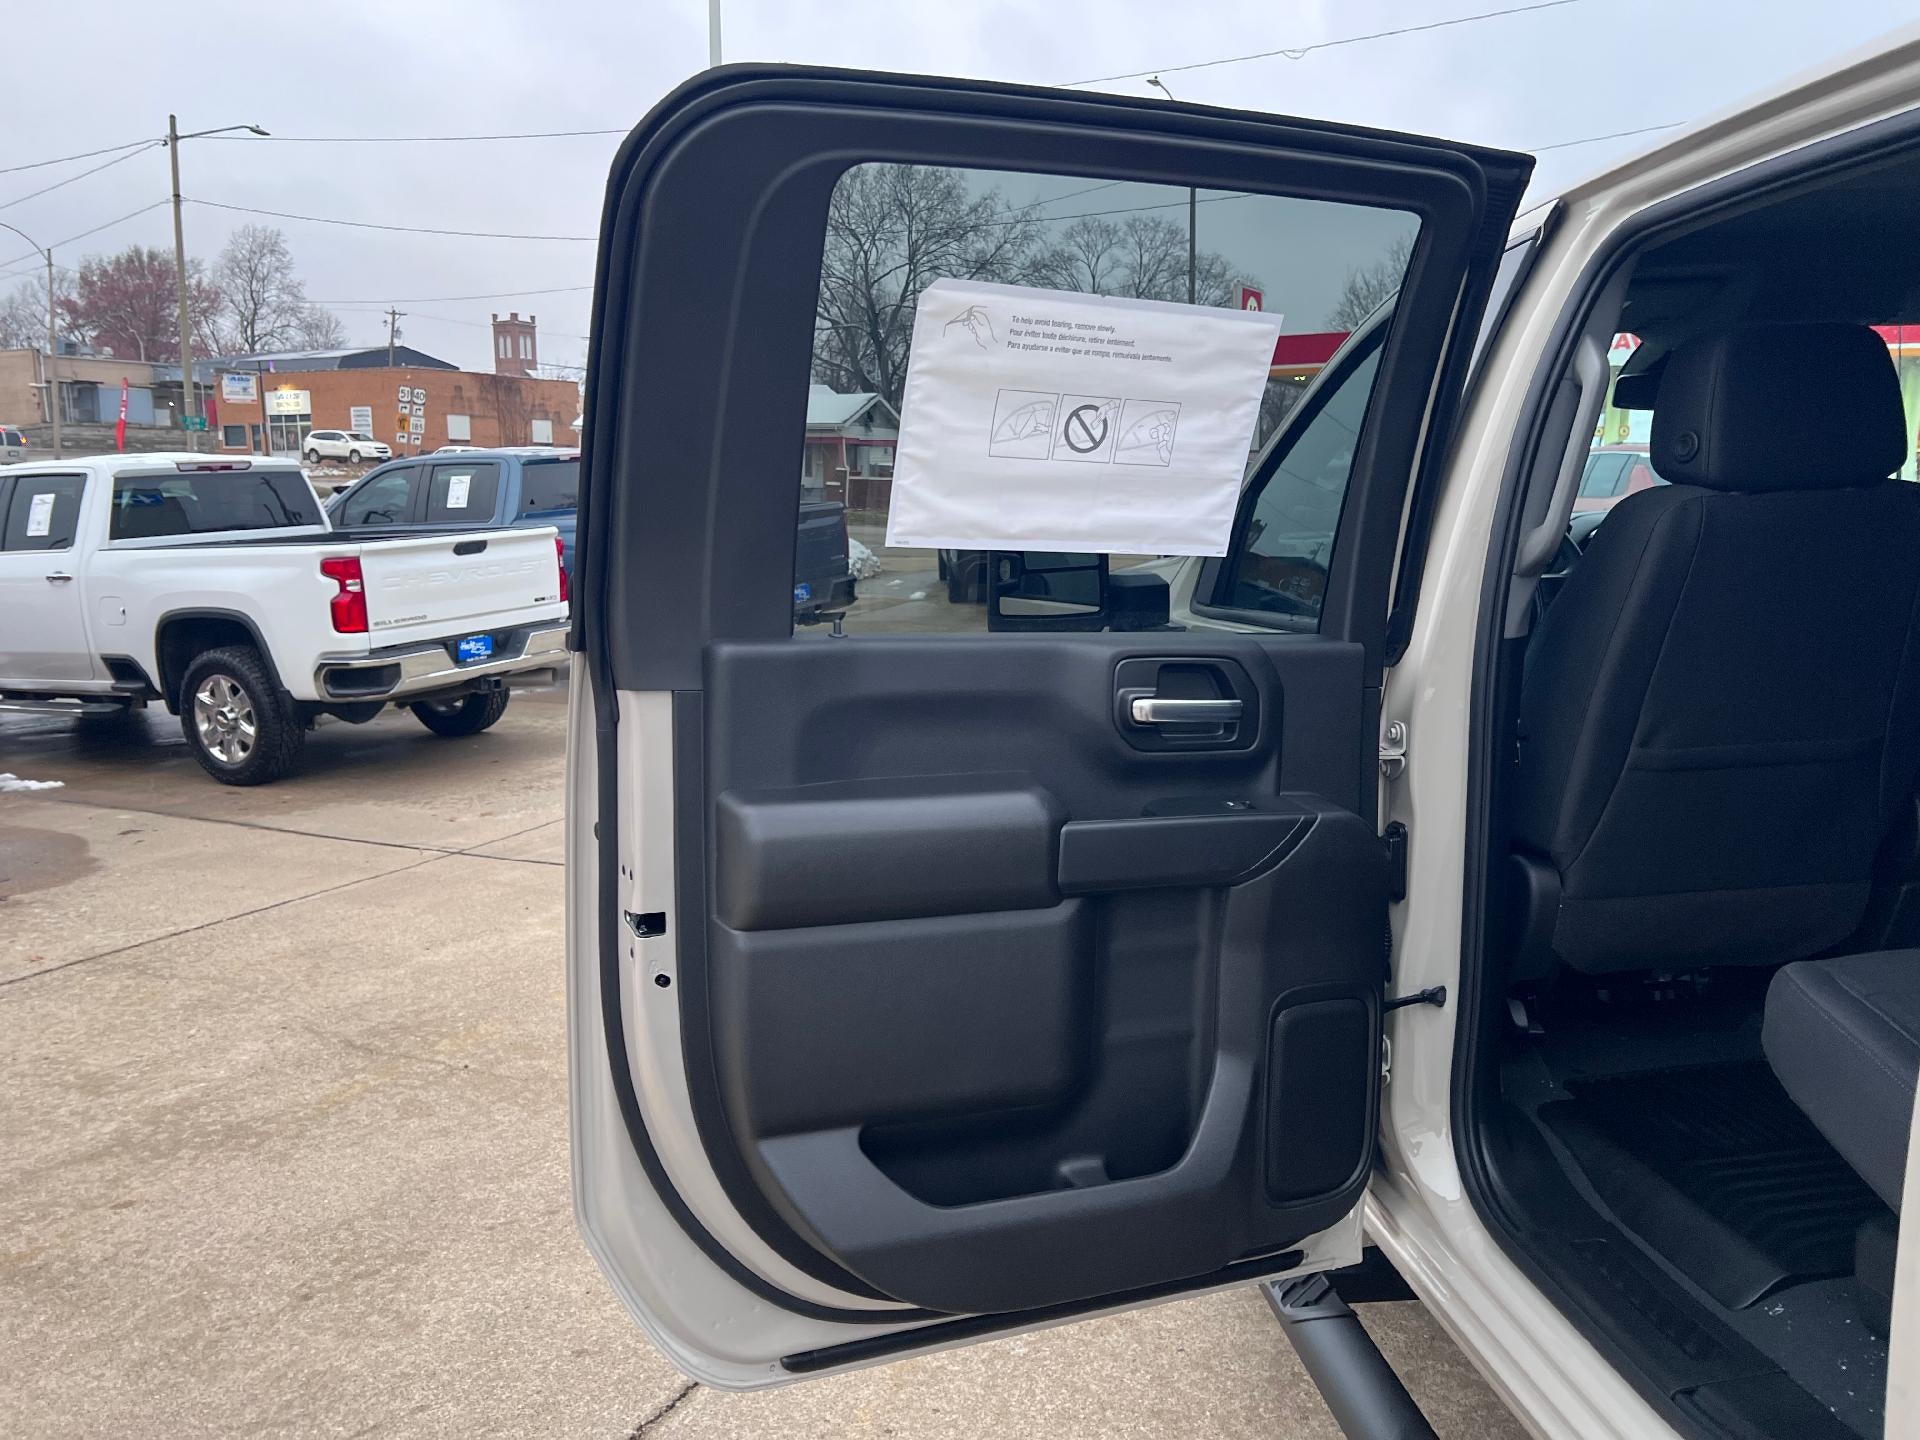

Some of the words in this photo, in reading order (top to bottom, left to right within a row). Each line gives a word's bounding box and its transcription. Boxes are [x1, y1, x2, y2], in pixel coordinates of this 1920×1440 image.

[1012, 315, 1020, 323] To
[1021, 317, 1033, 325] help
[1034, 319, 1050, 327] avoid
[1051, 319, 1074, 330] tearing,
[1075, 323, 1096, 331] remove
[1097, 324, 1116, 334] slowly.
[1009, 328, 1023, 337] Pour
[1024, 330, 1041, 338] éviter
[1042, 331, 1057, 340] toute
[1007, 340, 1020, 349] Para
[1054, 346, 1071, 354] evitar
[1071, 348, 1082, 356] que
[400, 388, 410, 400] 51
[414, 391, 425, 401] 40
